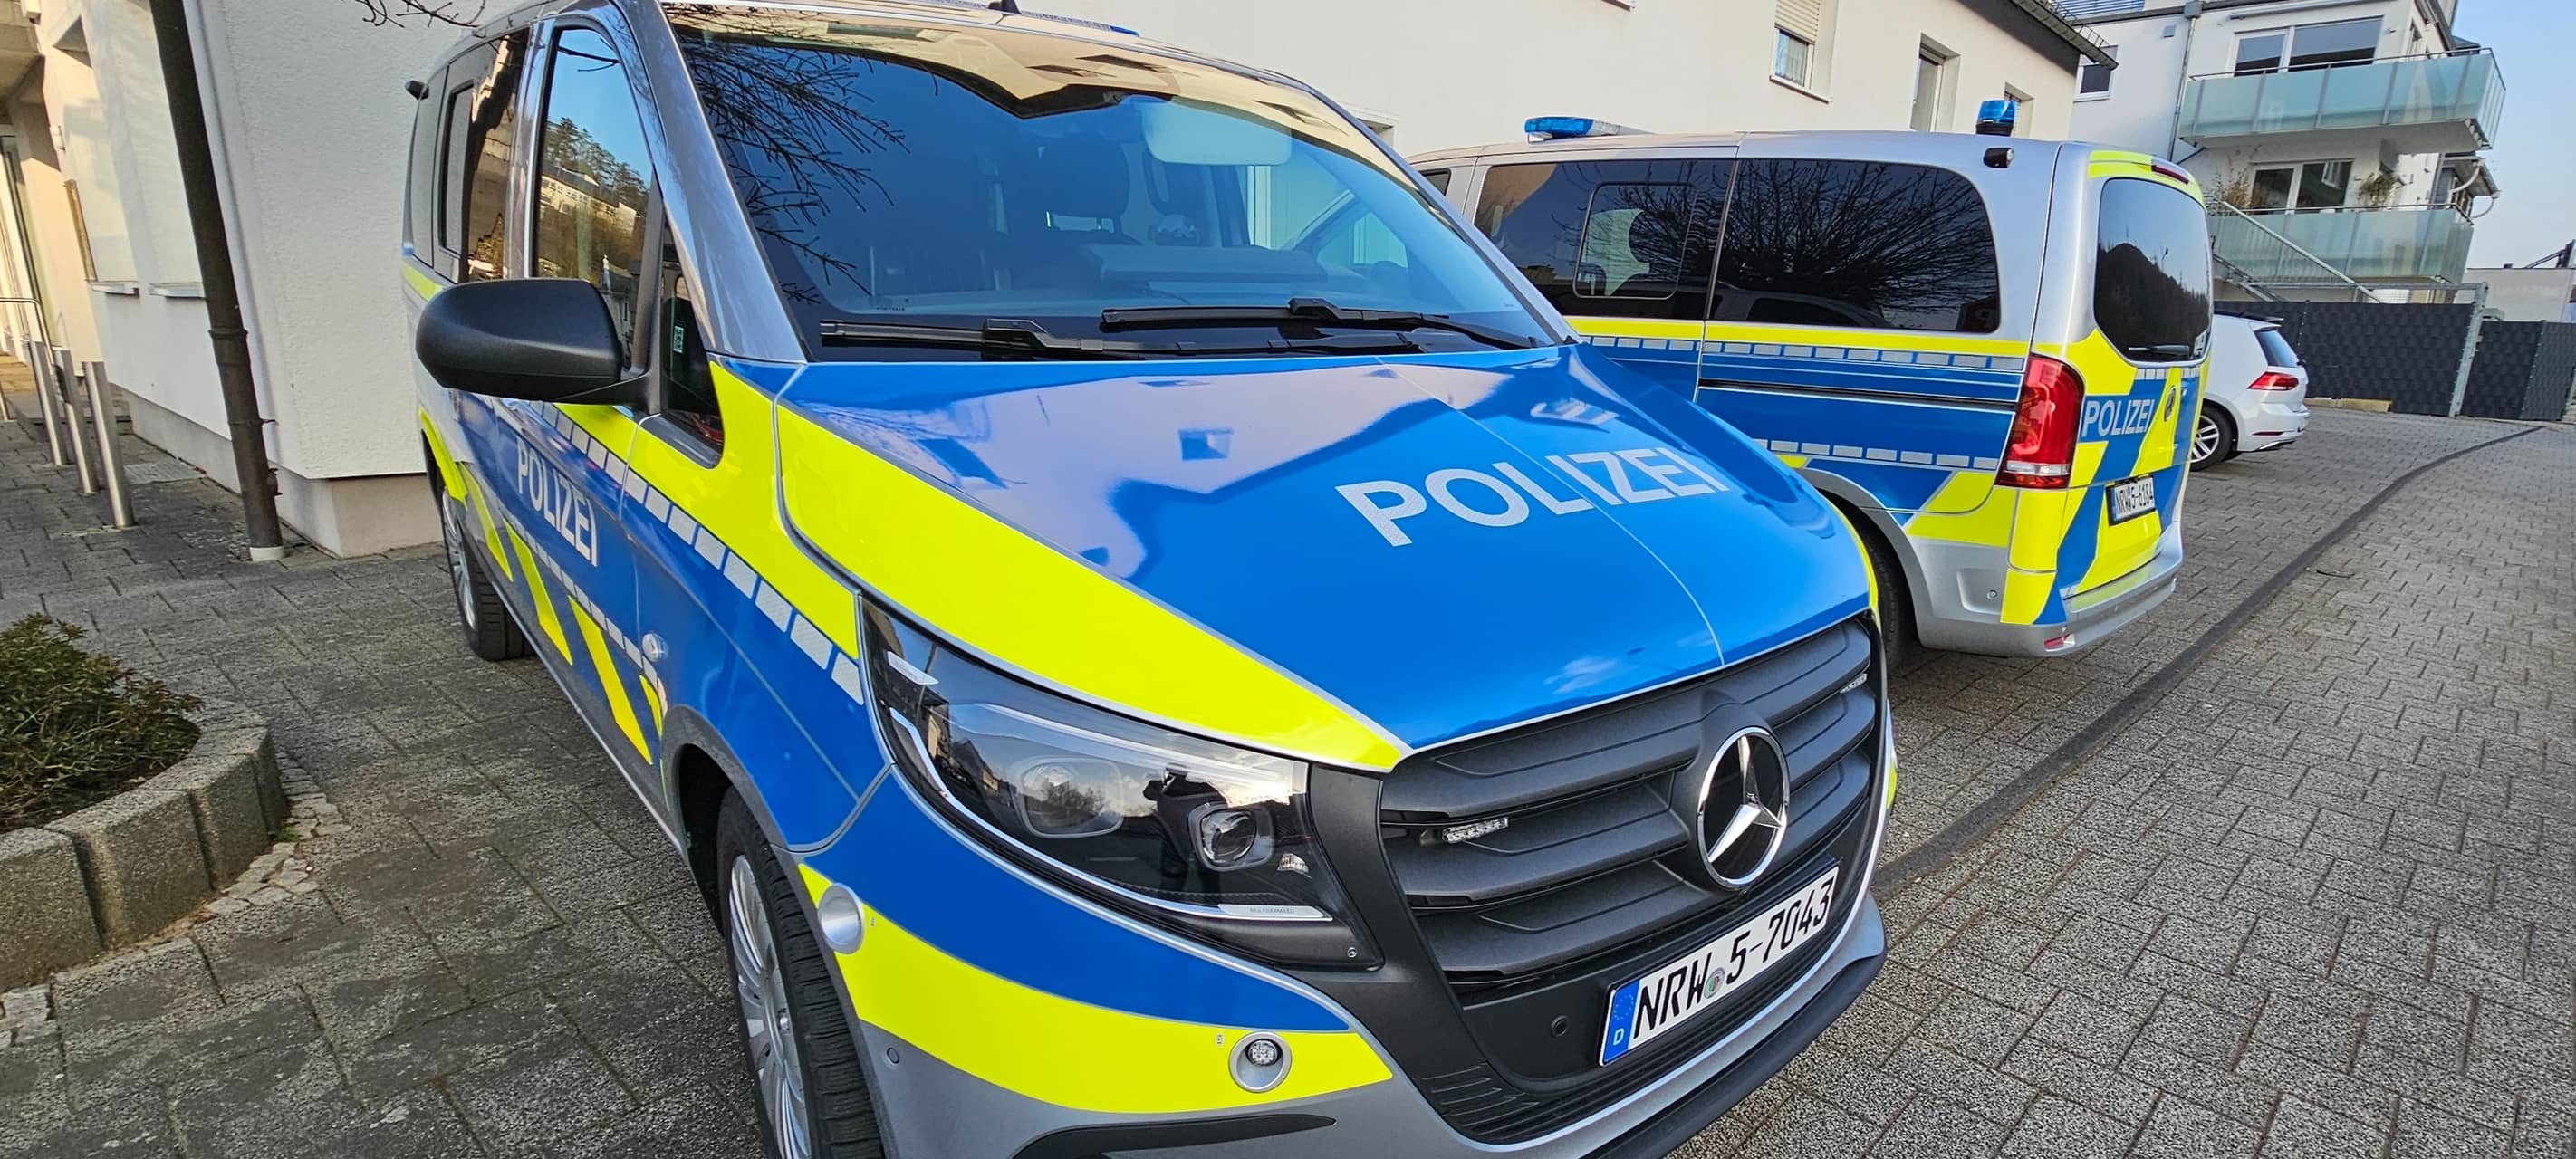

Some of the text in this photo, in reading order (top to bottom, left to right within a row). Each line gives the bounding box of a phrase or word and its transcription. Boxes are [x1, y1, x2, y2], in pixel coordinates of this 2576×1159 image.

[2081, 399, 2155, 437] POLIZEI
[516, 435, 598, 568] POLIZEI
[1334, 447, 1730, 548] POLIZEI
[1613, 876, 1834, 1046] D NRW 5-7043
